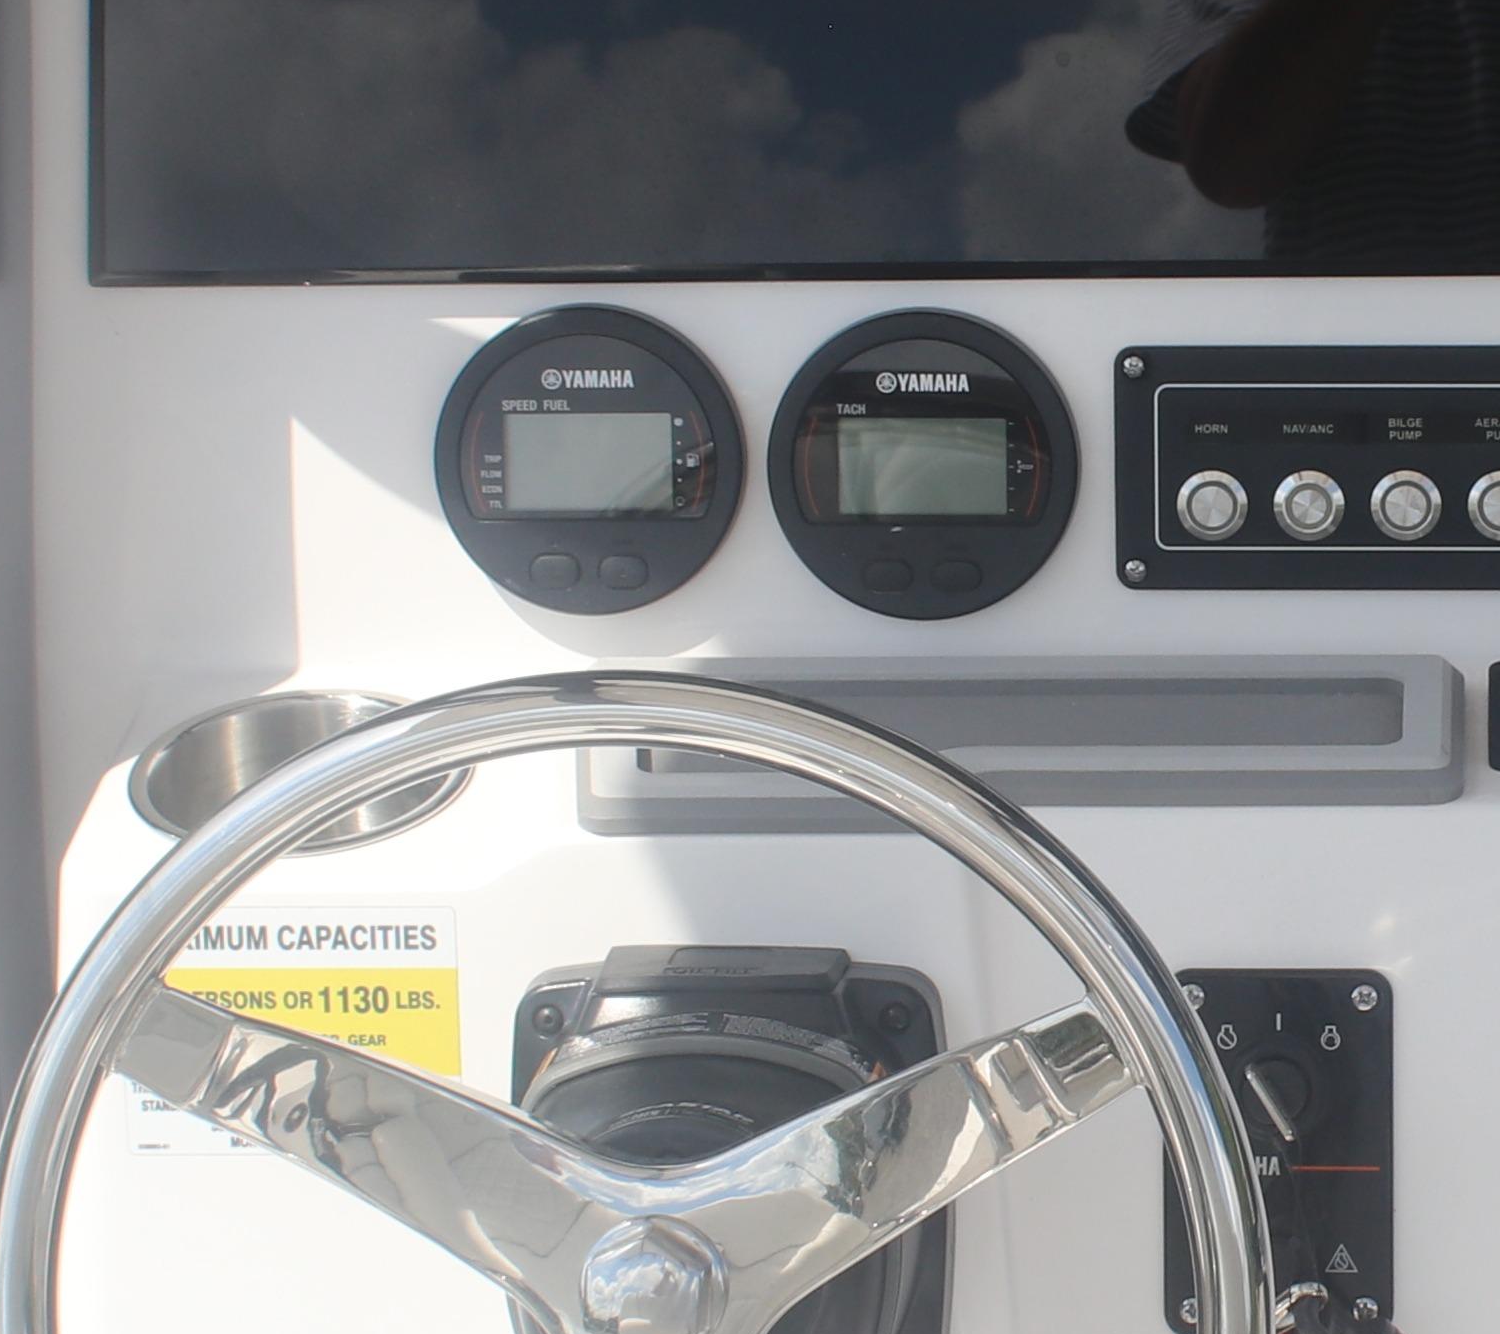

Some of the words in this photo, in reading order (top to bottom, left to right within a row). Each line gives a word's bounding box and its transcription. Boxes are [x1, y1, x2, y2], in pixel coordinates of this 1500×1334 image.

[562, 370, 633, 389] YAMAHA
[897, 374, 970, 392] YAMAHA
[502, 400, 537, 411] SPEED
[543, 400, 570, 410] FUEL
[837, 404, 866, 415] TACH
[1388, 418, 1422, 428] BILGE
[1195, 424, 1228, 434] HORN
[1283, 424, 1333, 434] NAV/ANC
[1389, 430, 1422, 440] PUMP
[485, 454, 503, 464] TRIP
[277, 924, 437, 951] CAPACITIES
[283, 991, 313, 1010] OR
[318, 986, 390, 1014] 1130
[396, 991, 441, 1010] LBS.
[348, 1034, 387, 1047] GEAR
